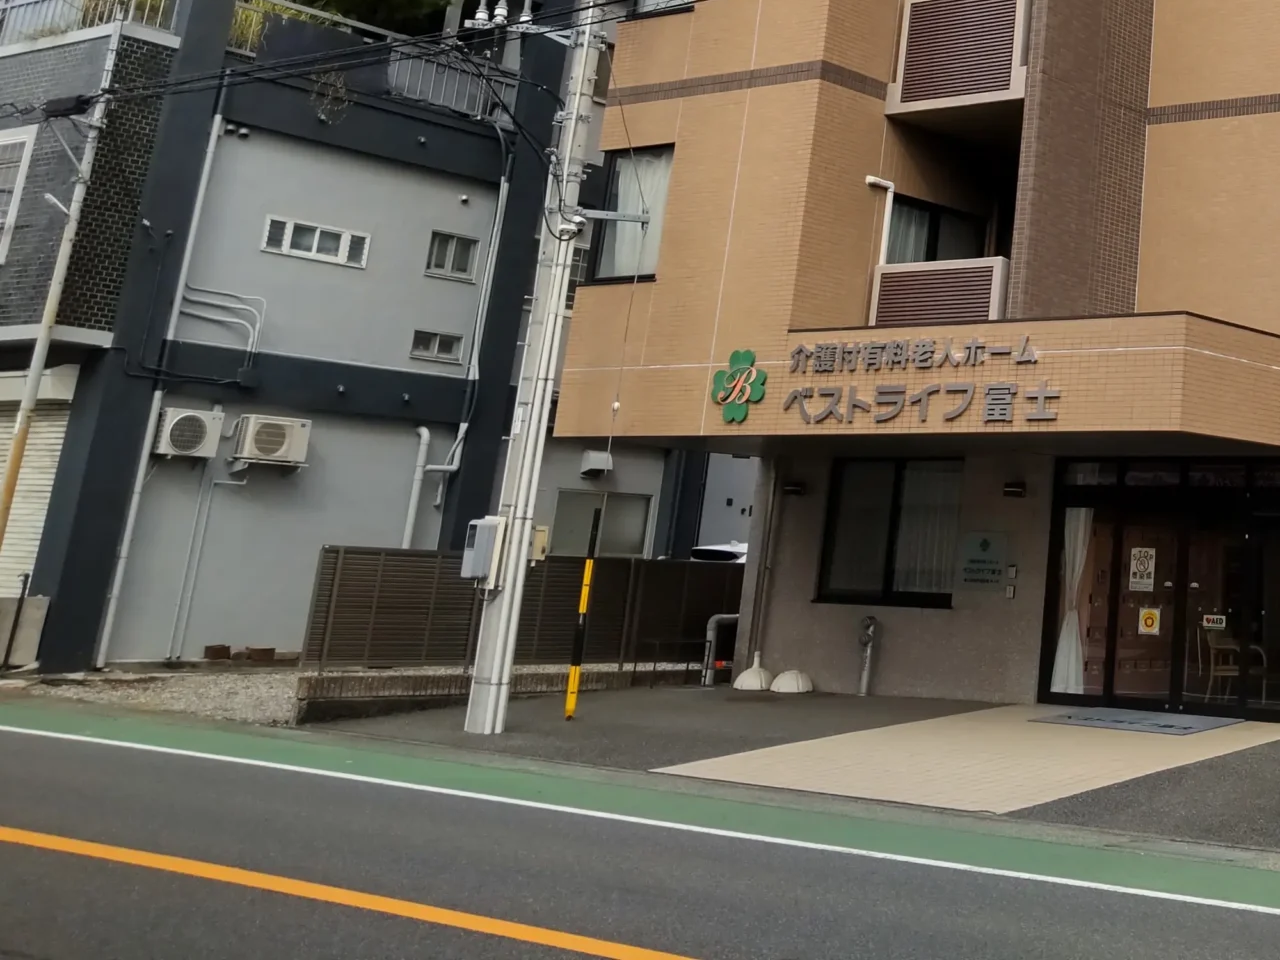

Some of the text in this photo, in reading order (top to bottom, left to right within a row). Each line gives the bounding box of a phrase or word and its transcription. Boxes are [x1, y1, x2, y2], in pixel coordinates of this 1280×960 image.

[790, 335, 1038, 373] 介護付有料老人ホーム
[784, 380, 1061, 424] ベストライフ富士
[1132, 550, 1154, 561] STOP
[1211, 617, 1224, 625] AED
